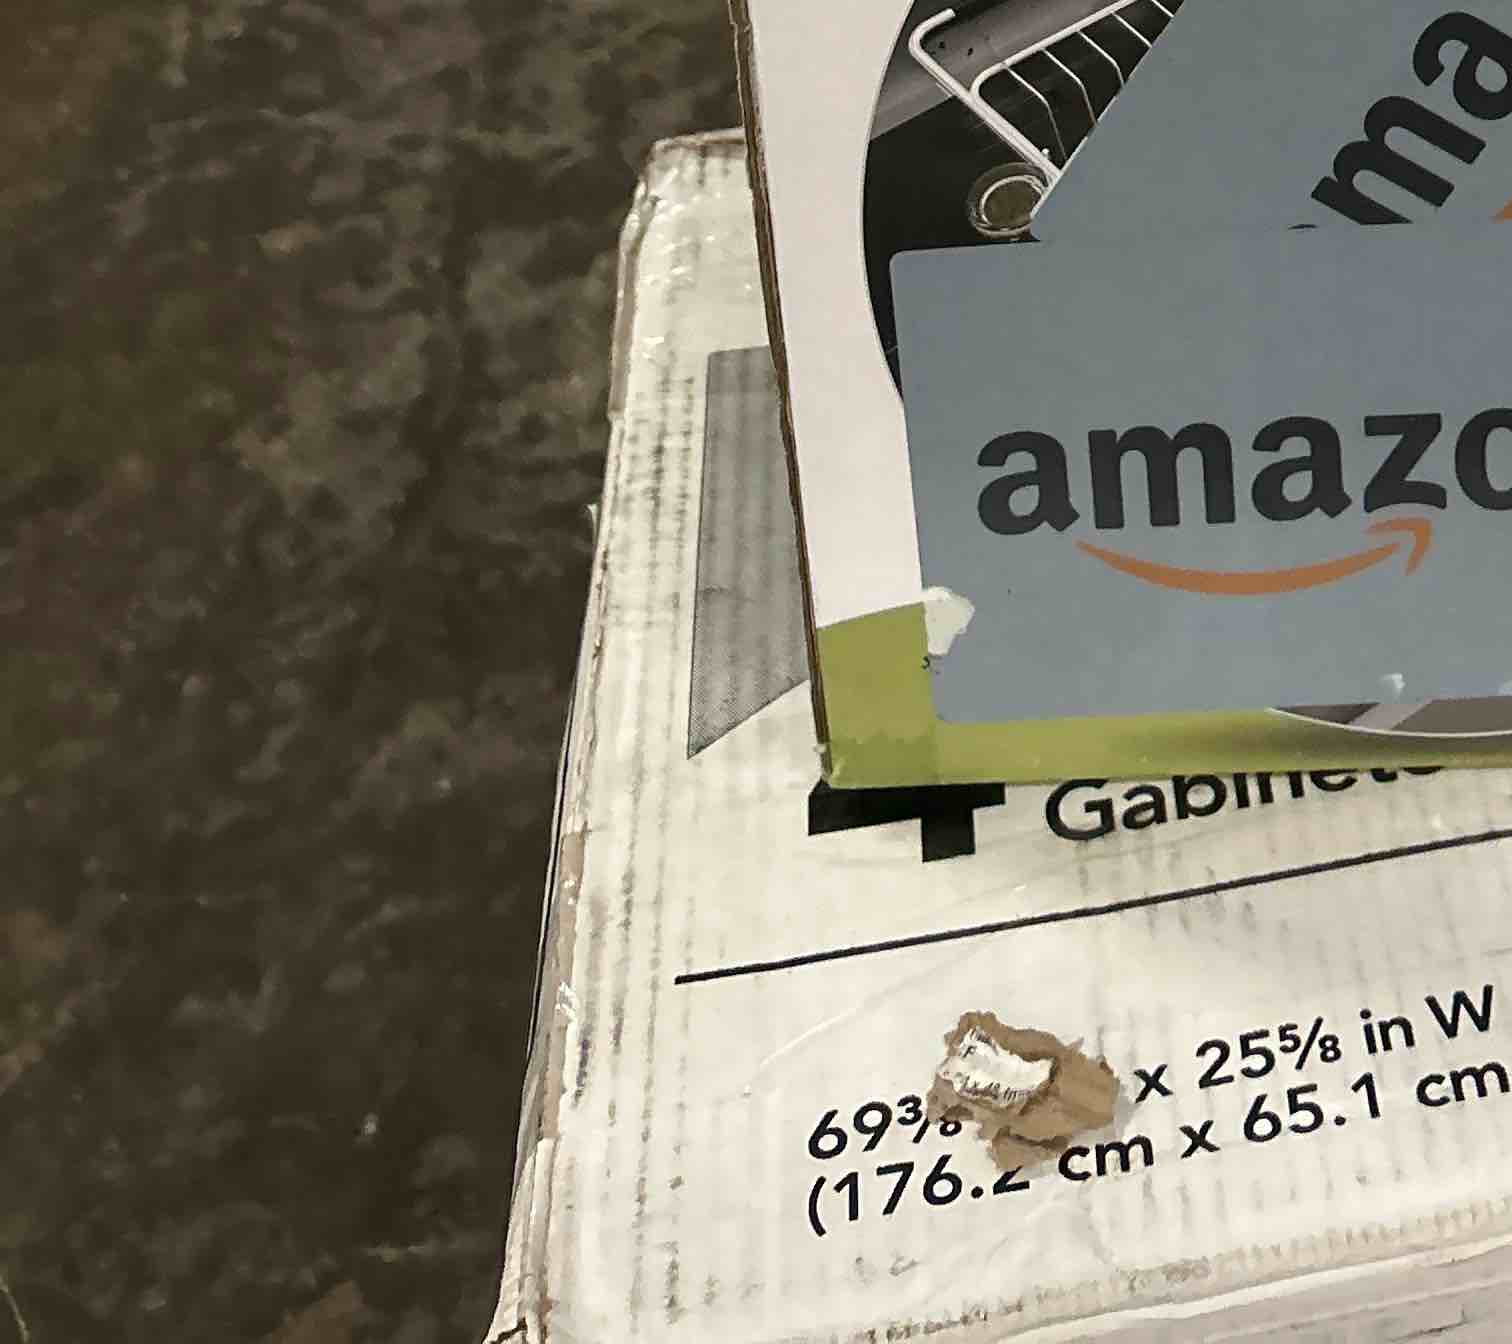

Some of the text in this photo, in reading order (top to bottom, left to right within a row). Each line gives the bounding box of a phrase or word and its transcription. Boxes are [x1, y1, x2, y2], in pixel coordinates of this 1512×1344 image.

[1134, 1064, 1174, 1103] x
[1359, 1008, 1415, 1055] in
[1424, 983, 1494, 1040] W
[1057, 1134, 1155, 1182] cm
[1179, 1119, 1221, 1159] x
[1243, 1071, 1381, 1143] 65.1
[1415, 1061, 1511, 1108] cm
